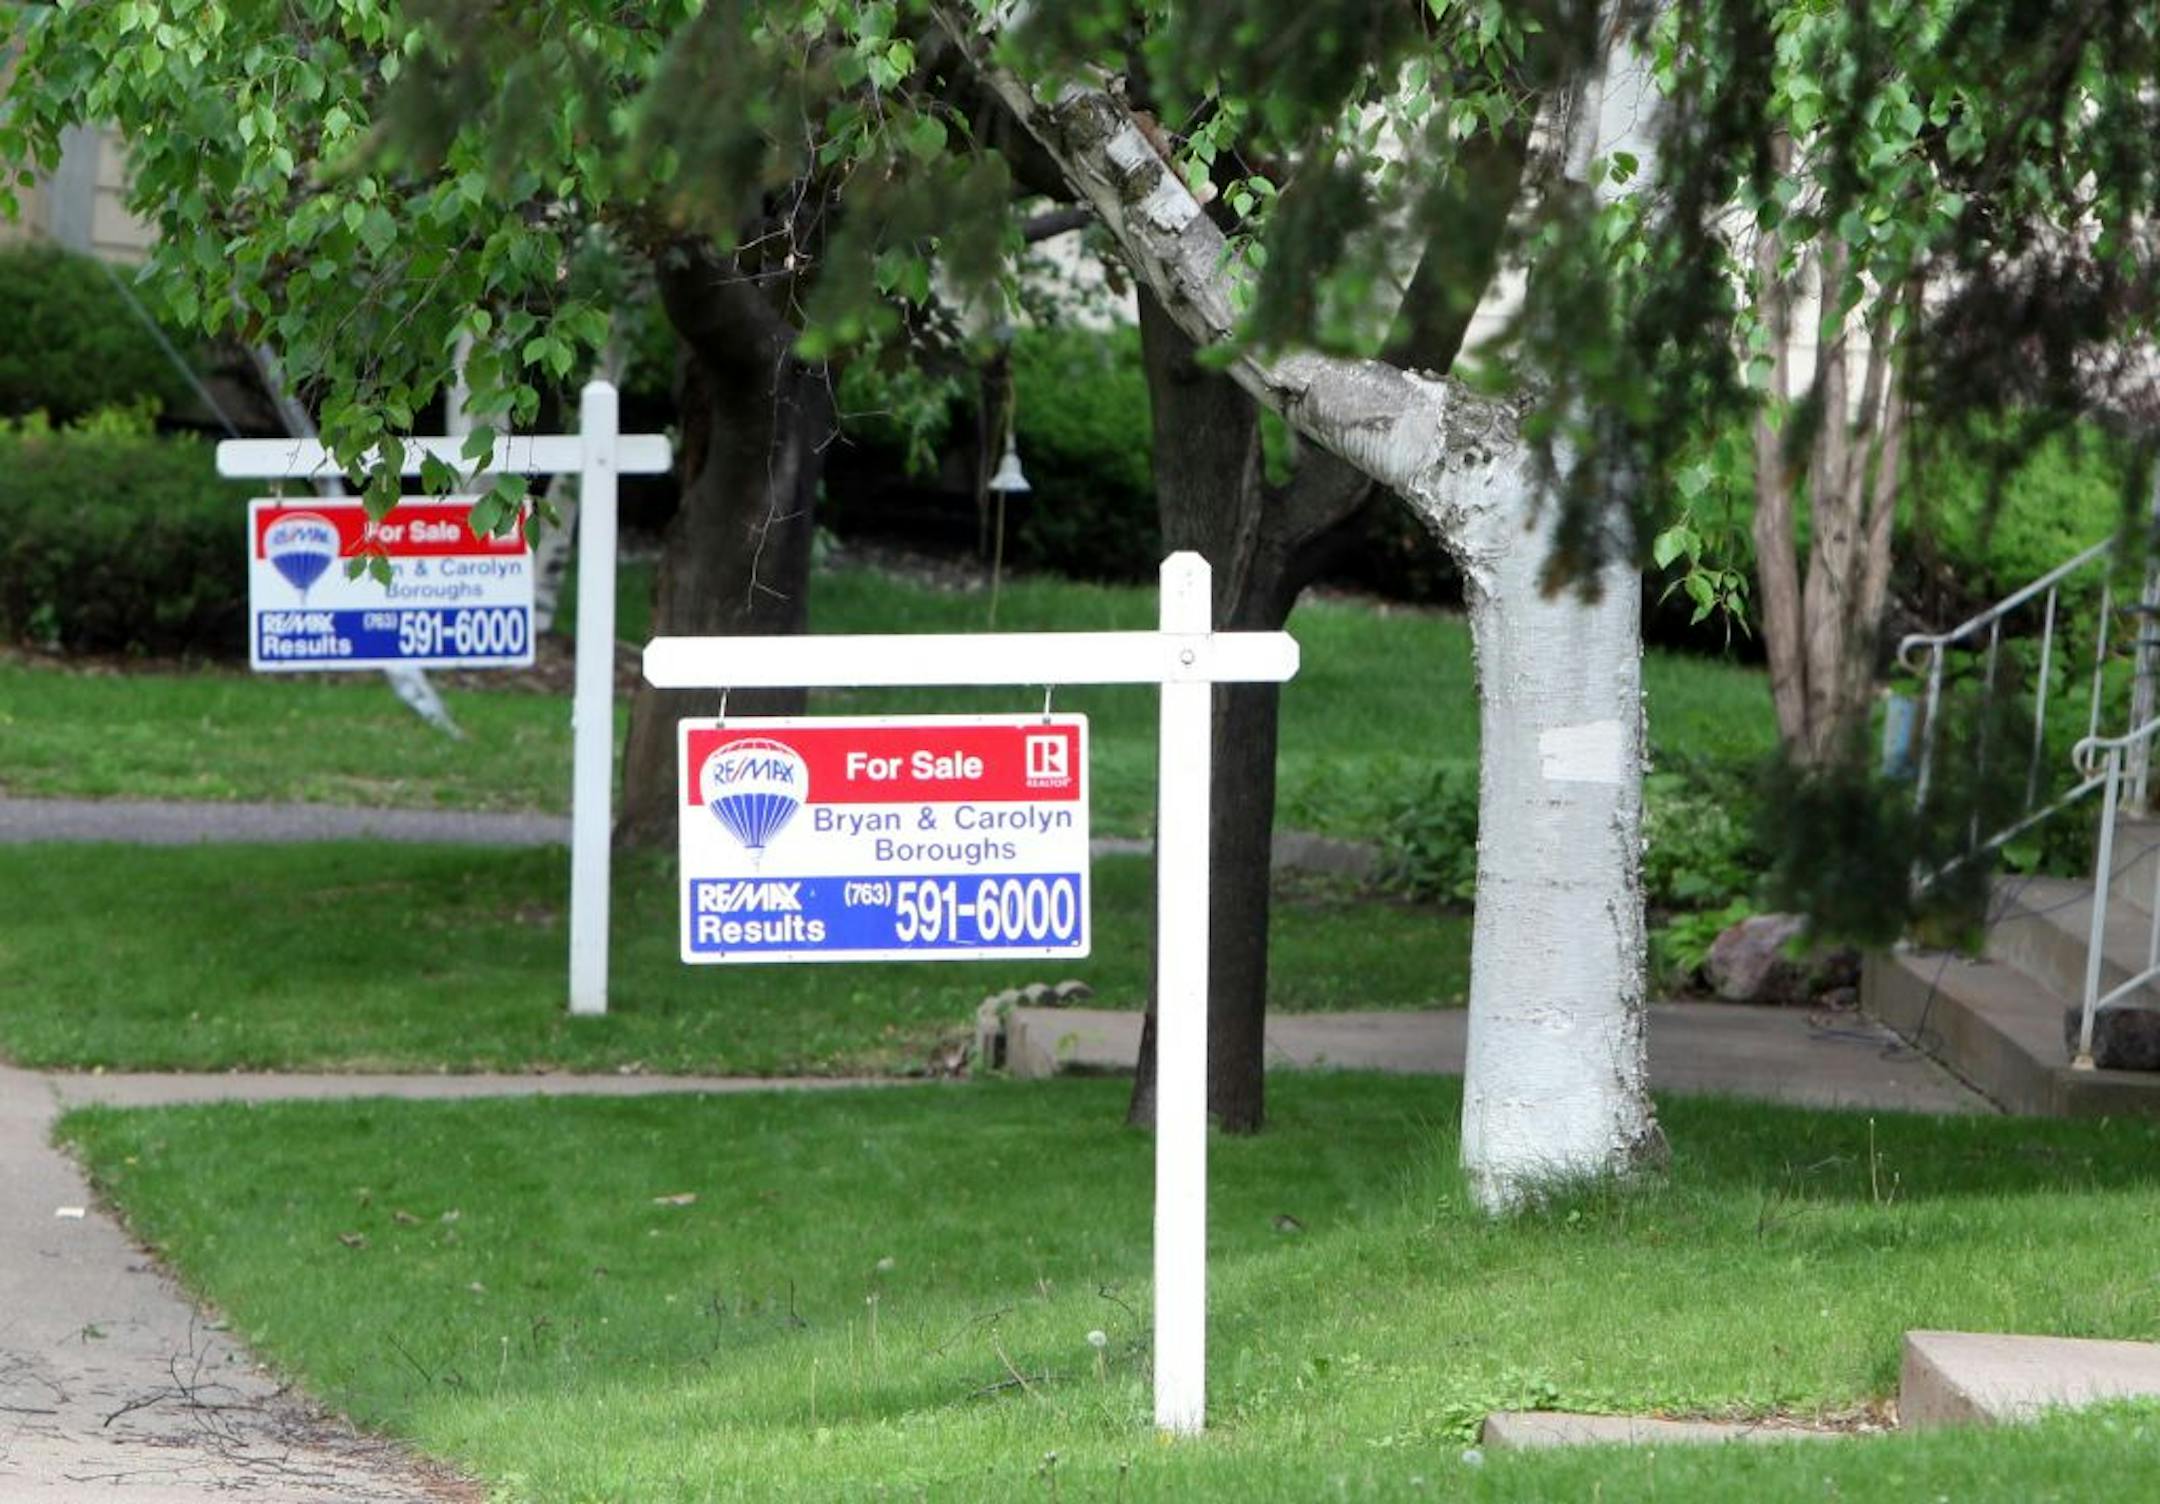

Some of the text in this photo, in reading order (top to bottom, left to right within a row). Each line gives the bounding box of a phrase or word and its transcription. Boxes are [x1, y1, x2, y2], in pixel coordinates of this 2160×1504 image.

[410, 520, 460, 541] Sale
[415, 560, 428, 576] &
[440, 558, 522, 577] Carolyn
[262, 635, 352, 656] Results
[399, 609, 524, 654] 591-6000
[714, 757, 795, 786] RE/MAX
[847, 750, 983, 781] For Sale
[814, 804, 1072, 835] Bryan & Carolyn
[875, 838, 1016, 865] Boroughs
[698, 882, 801, 913] RE/MAX
[844, 878, 1075, 941] (763) 591-6000
[698, 915, 826, 943] Results
